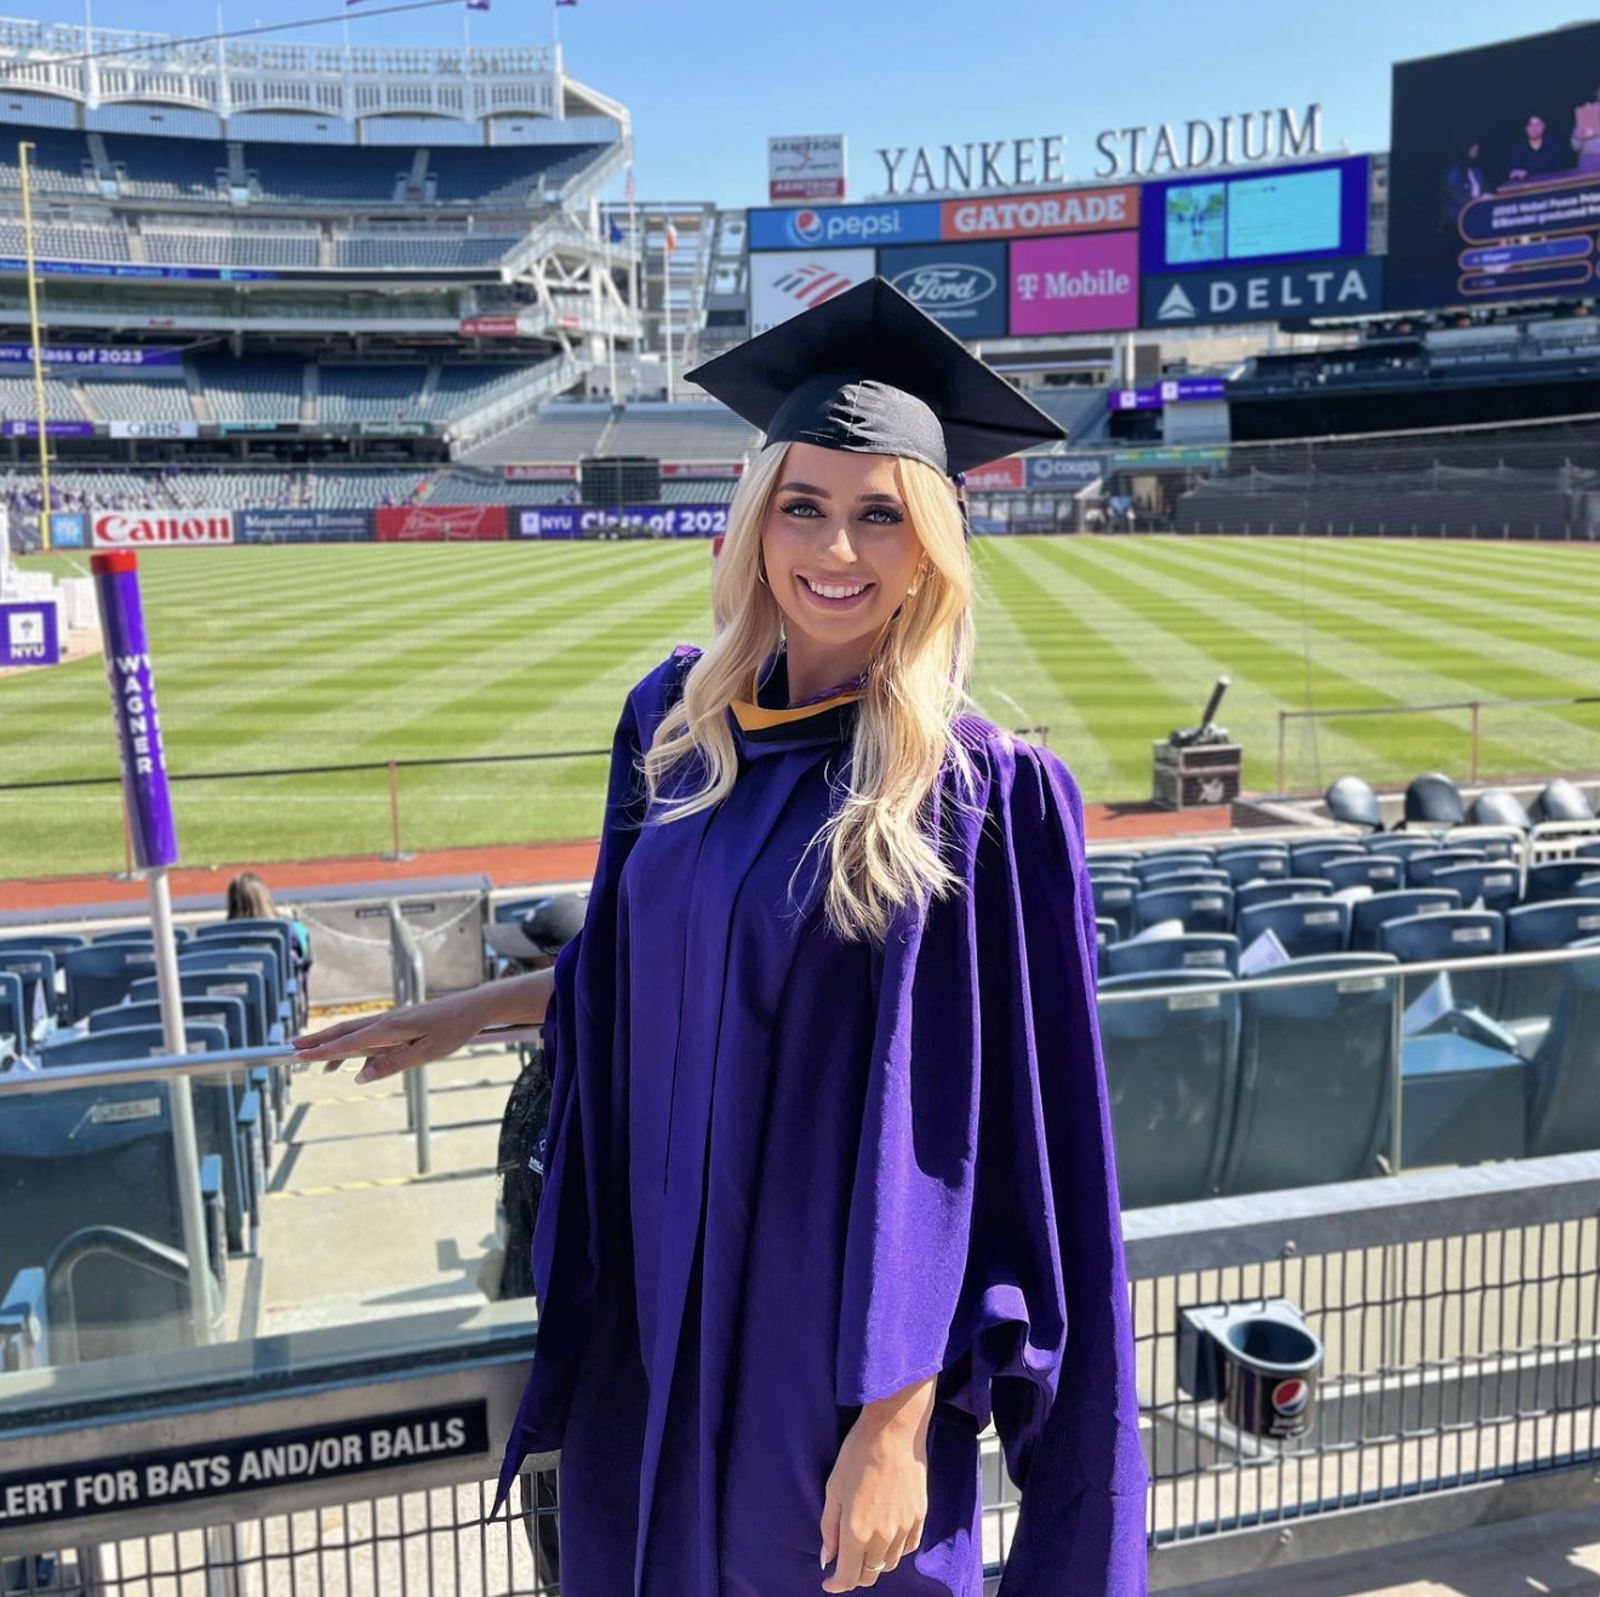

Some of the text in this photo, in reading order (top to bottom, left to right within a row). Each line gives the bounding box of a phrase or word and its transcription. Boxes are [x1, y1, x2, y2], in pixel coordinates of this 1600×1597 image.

[875, 103, 1320, 194] YANKEE STADIUM
[827, 210, 900, 241] pepsi
[954, 194, 1126, 233] GATORADE
[907, 270, 978, 301] Ford
[1045, 269, 1130, 299] Mobile
[1209, 269, 1368, 312] DELTA
[76, 349, 96, 363] of
[98, 349, 143, 364] 2023
[127, 420, 181, 437] ORIS
[95, 514, 231, 542] Canon
[541, 514, 573, 530] NYU
[649, 510, 677, 532] of
[680, 511, 727, 532] 202
[11, 643, 46, 659] NYU
[115, 653, 153, 775] WAGNER
[0, 1417, 466, 1519] ERT FOR BATS AND/OR BALLS
